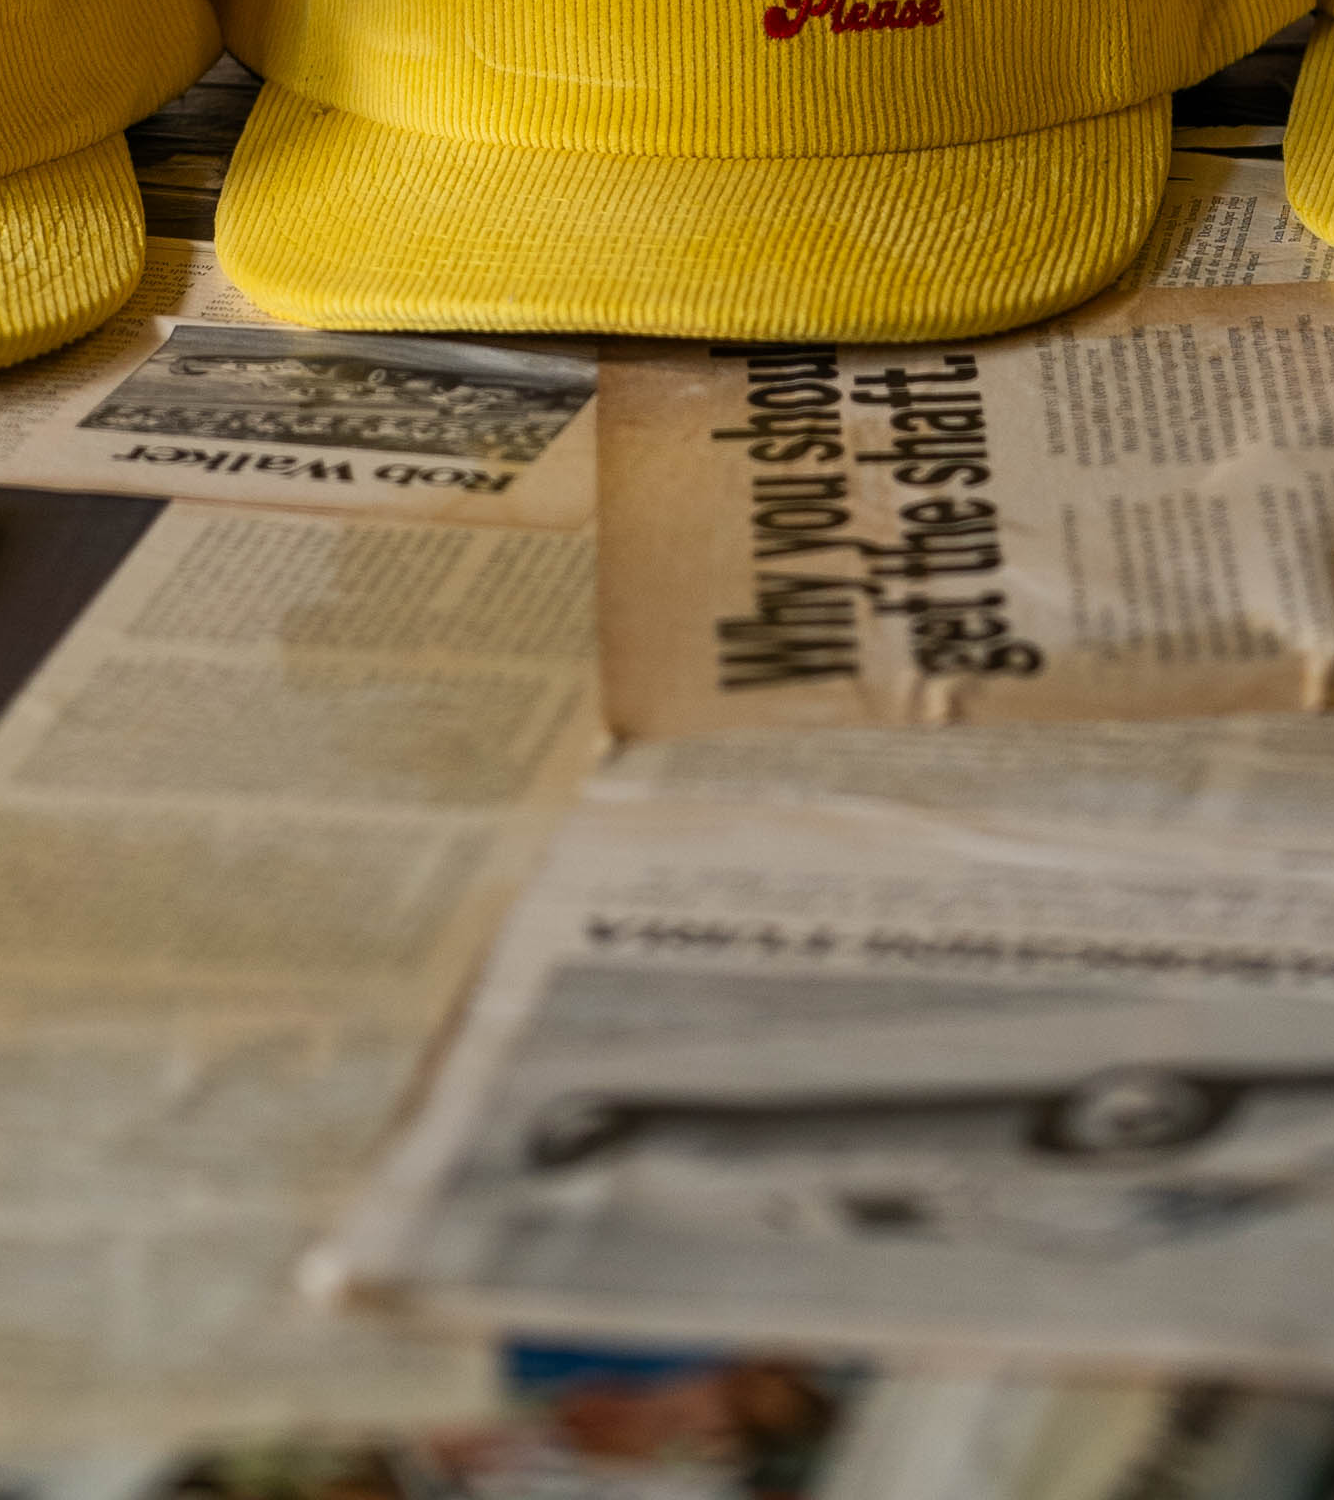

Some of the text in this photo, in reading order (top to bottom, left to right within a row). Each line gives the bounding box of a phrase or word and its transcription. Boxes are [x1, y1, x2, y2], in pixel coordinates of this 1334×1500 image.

[112, 442, 519, 494] Rob Walker
[709, 344, 886, 695] Why you shoul
[850, 353, 1046, 680] get the shaft.
